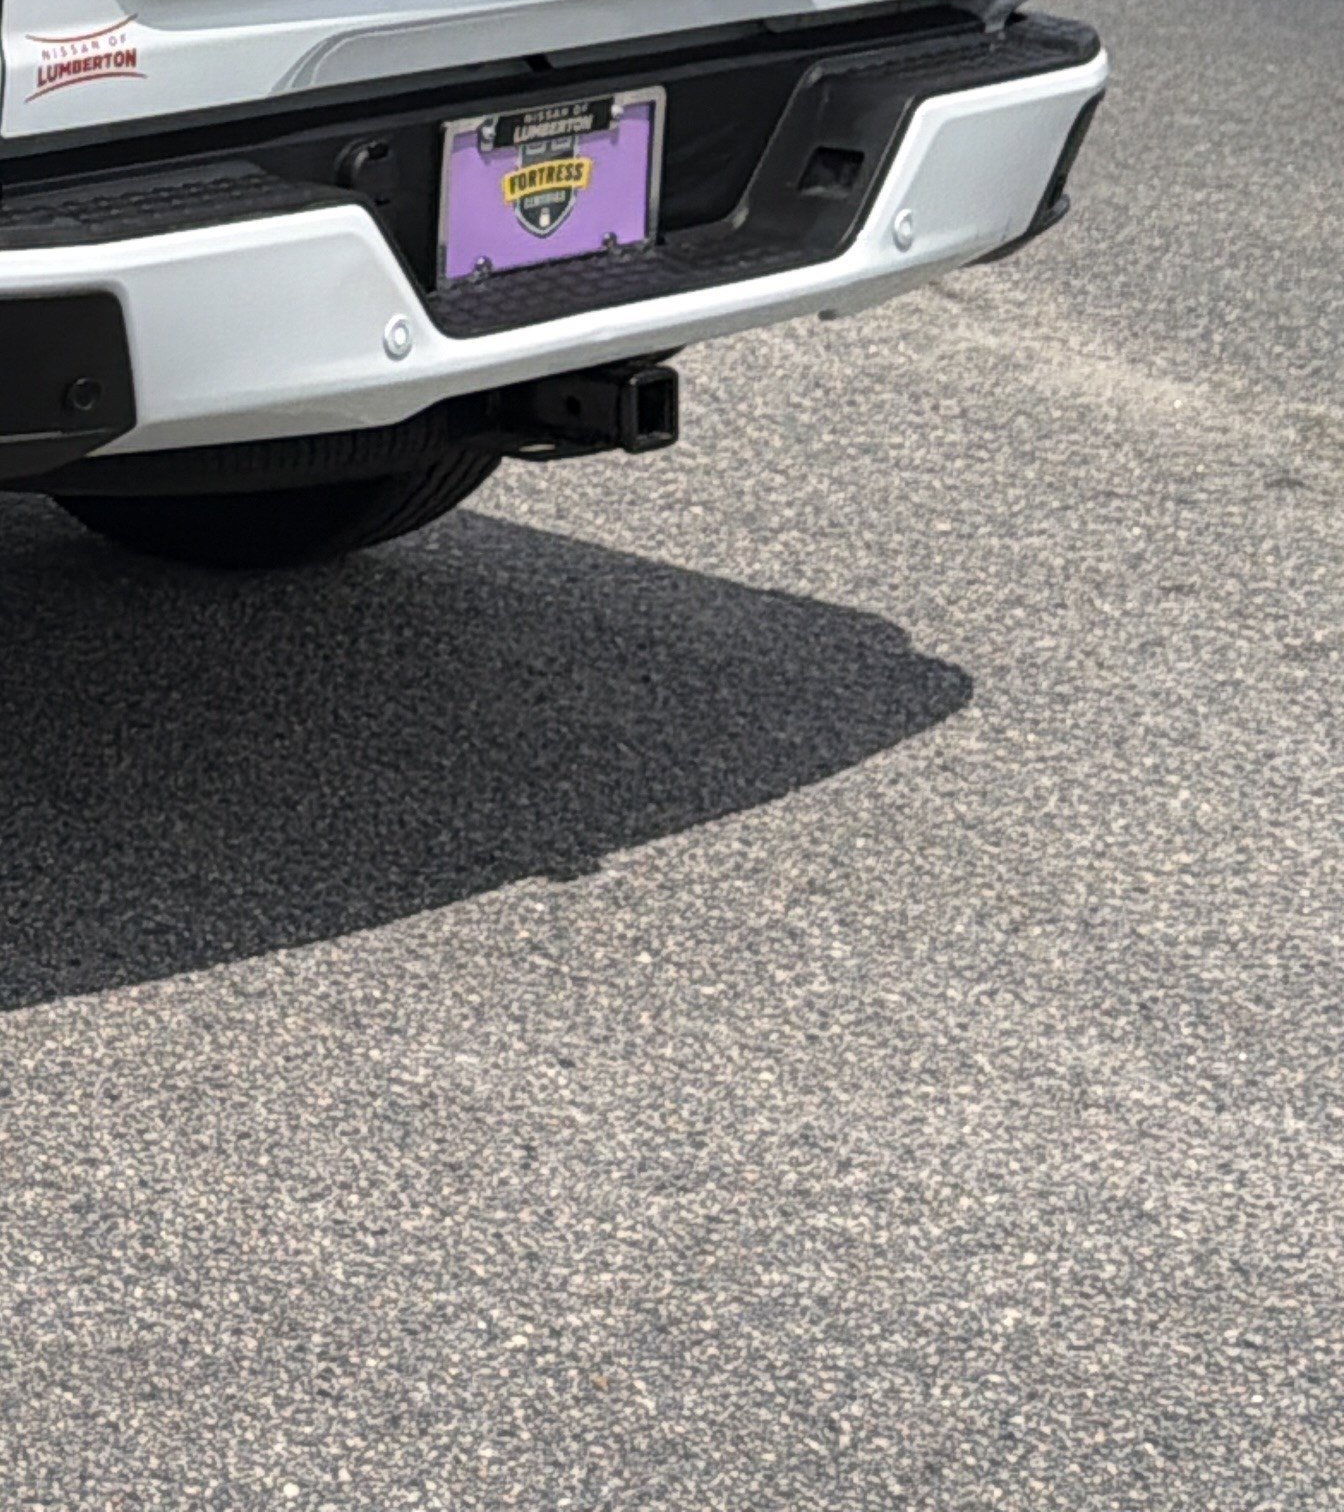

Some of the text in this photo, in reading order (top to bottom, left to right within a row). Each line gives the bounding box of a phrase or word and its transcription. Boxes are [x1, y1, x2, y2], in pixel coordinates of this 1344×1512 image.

[41, 34, 127, 60] NISSAN OF
[37, 48, 137, 87] LUMBERTON
[509, 162, 585, 195] FORTRESS
